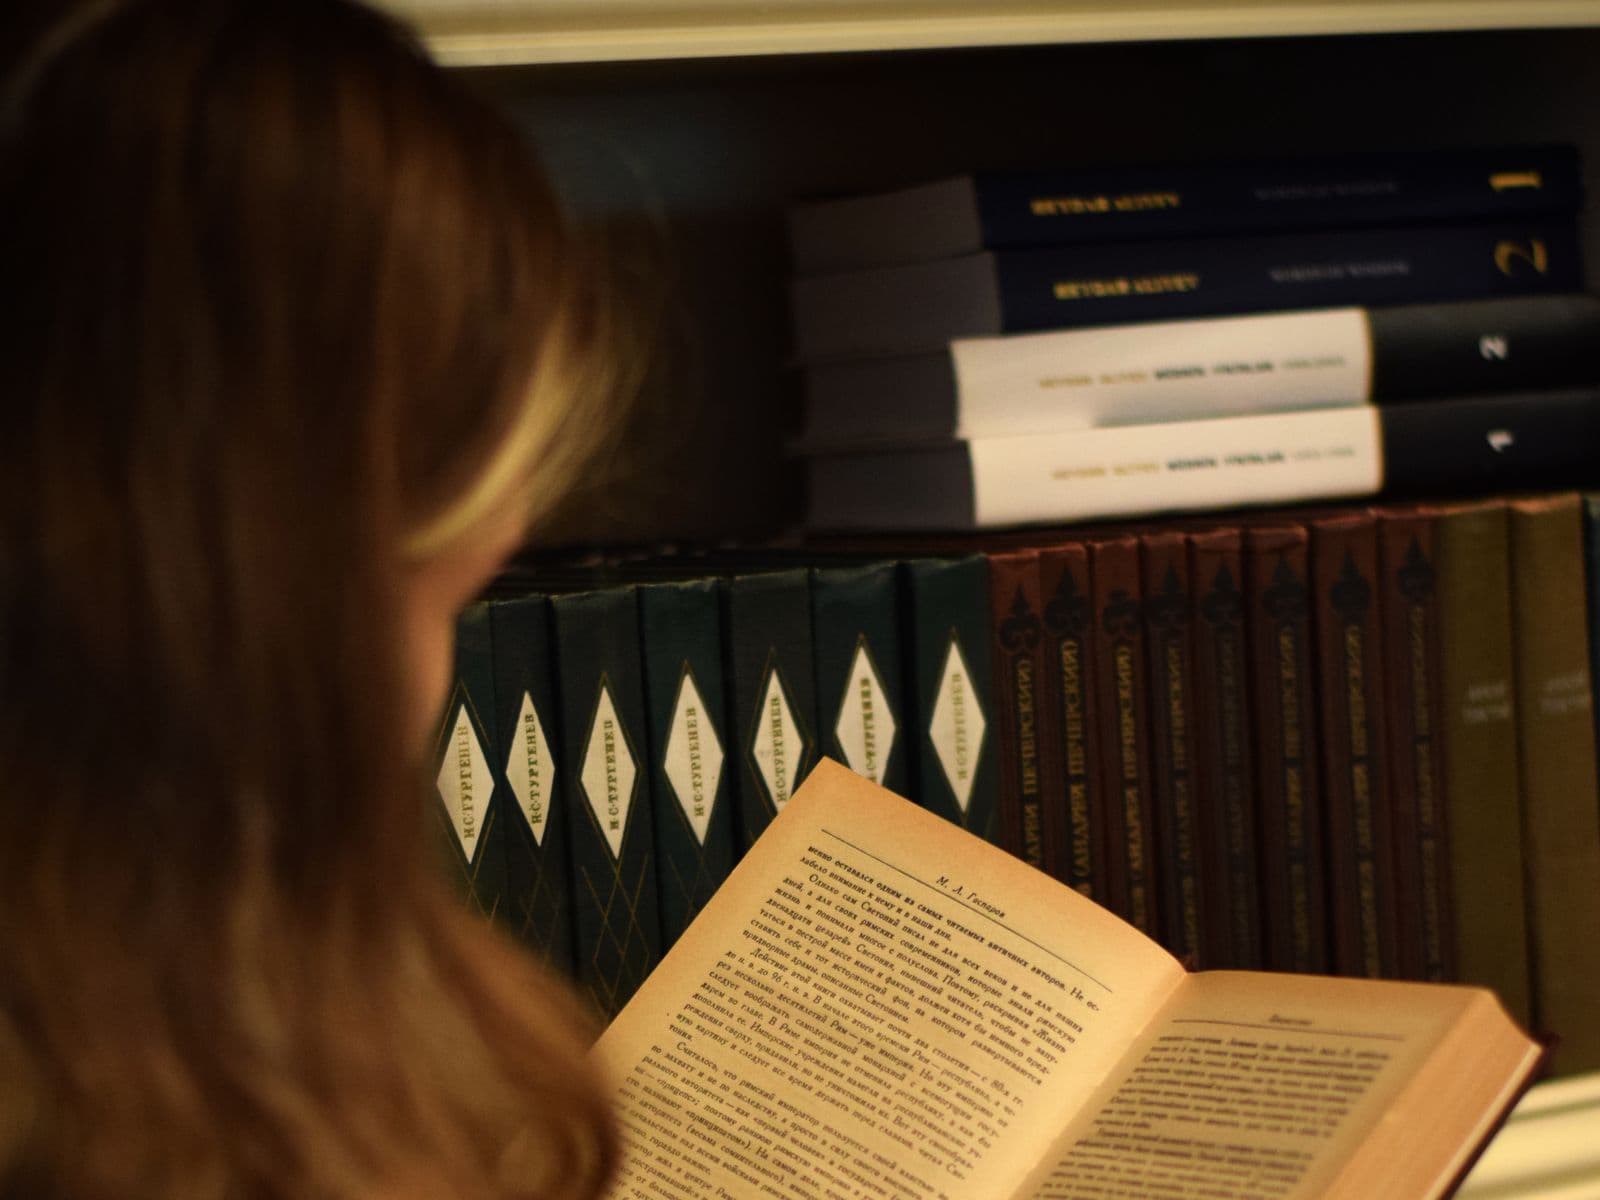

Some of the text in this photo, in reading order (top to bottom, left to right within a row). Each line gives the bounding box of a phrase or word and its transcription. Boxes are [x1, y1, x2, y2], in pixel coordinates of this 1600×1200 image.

[1493, 237, 1548, 276] 2
[1478, 334, 1508, 361] 2
[775, 887, 801, 904] жизнь
[816, 909, 855, 933] понимали
[859, 932, 886, 949] многое
[800, 857, 828, 874] лабело
[829, 872, 866, 894] внимание
[875, 897, 895, 911] нему
[911, 916, 933, 930] наши
[808, 846, 832, 861] менно
[834, 860, 874, 884] оставался
[876, 882, 902, 898] одним
[917, 904, 943, 920] самых
[945, 919, 985, 942] читаемых
[987, 942, 1028, 967] античных
[743, 930, 790, 958] придворные
[821, 972, 864, 998] описанные
[750, 918, 782, 938] ставить
[784, 937, 802, 949] себе
[815, 954, 829, 964] тот
[832, 963, 888, 995] исторический
[931, 1017, 966, 1038] котором
[759, 908, 786, 925] таться
[796, 929, 829, 948] пестрой
[829, 947, 852, 961] массе
[854, 960, 875, 973] имен
[918, 995, 950, 1014] должен
[951, 1013, 971, 1026] хотя
[766, 898, 812, 925] двенадцати
[900, 970, 944, 995] нынешний
[808, 874, 839, 895] Однако
[842, 894, 857, 904] сам
[860, 901, 901, 926] Светоний
[902, 925, 926, 941] писал
[942, 947, 959, 958] для
[962, 958, 980, 970] всех
[983, 969, 1008, 985] веков
[1035, 999, 1052, 1012] для
[816, 895, 832, 906] для
[835, 905, 857, 919] своих
[860, 919, 894, 939] римских
[968, 976, 1002, 998] которые
[1008, 999, 1034, 1016] знали
